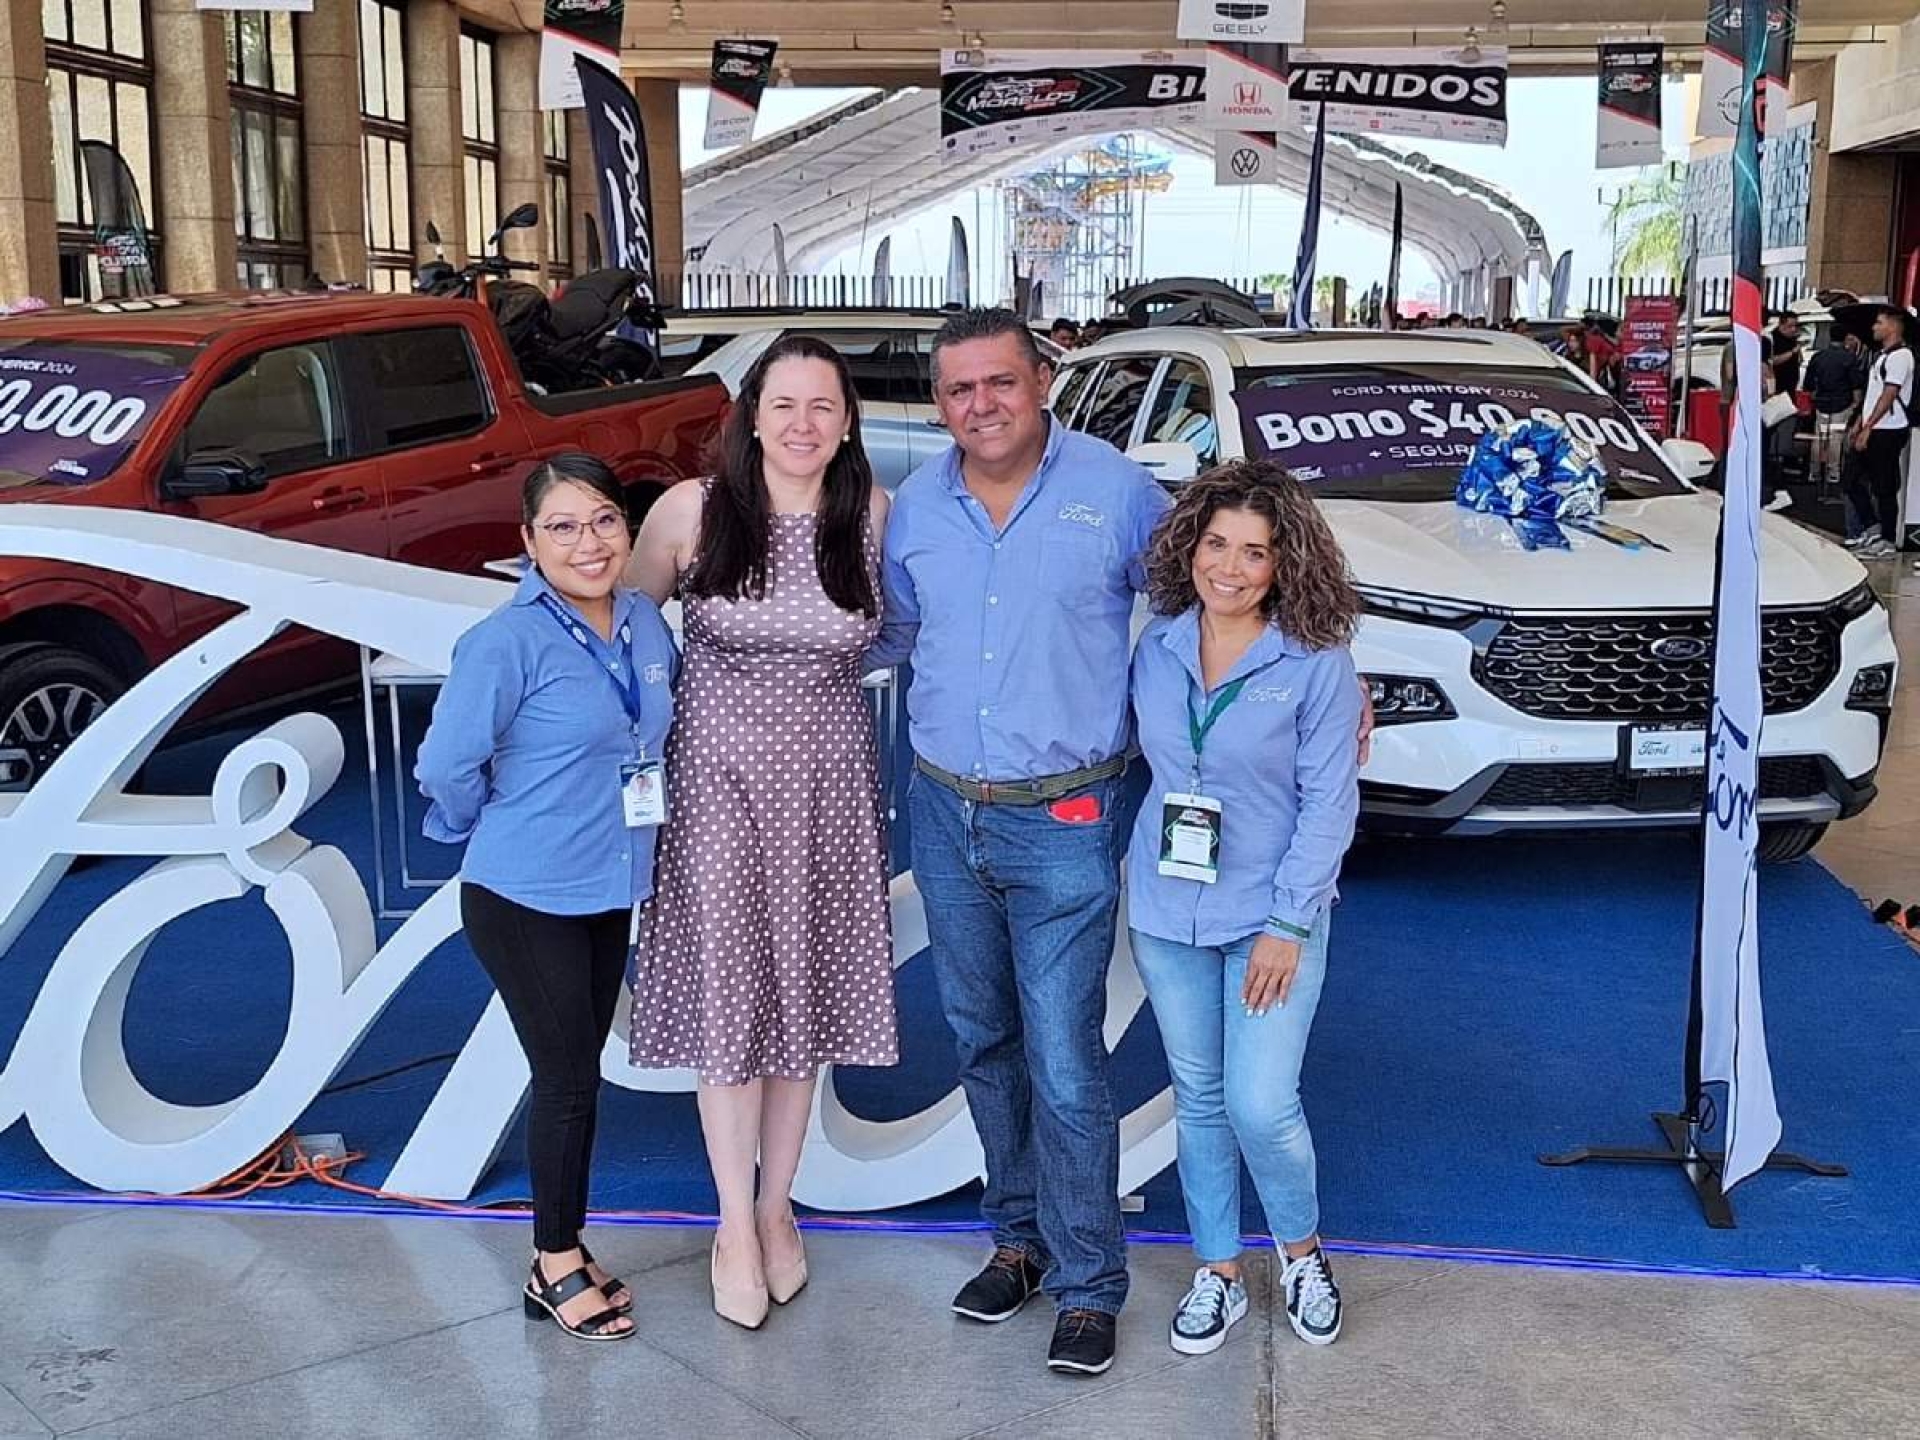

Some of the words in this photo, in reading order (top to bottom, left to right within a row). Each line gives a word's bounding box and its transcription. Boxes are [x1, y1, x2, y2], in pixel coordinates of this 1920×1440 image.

[1213, 23, 1268, 34] GEELY
[1222, 106, 1273, 116] HONDA
[1331, 384, 1384, 396] FORD
[1385, 383, 1492, 397] TERRITORY
[1498, 388, 1540, 400] 2024
[0, 379, 147, 446] 0,000
[1254, 408, 1407, 451] Bono
[1388, 442, 1471, 460] SEGUR
[1059, 503, 1105, 528] Ford
[1247, 687, 1293, 702] Ford
[1637, 740, 1671, 756] Ford
